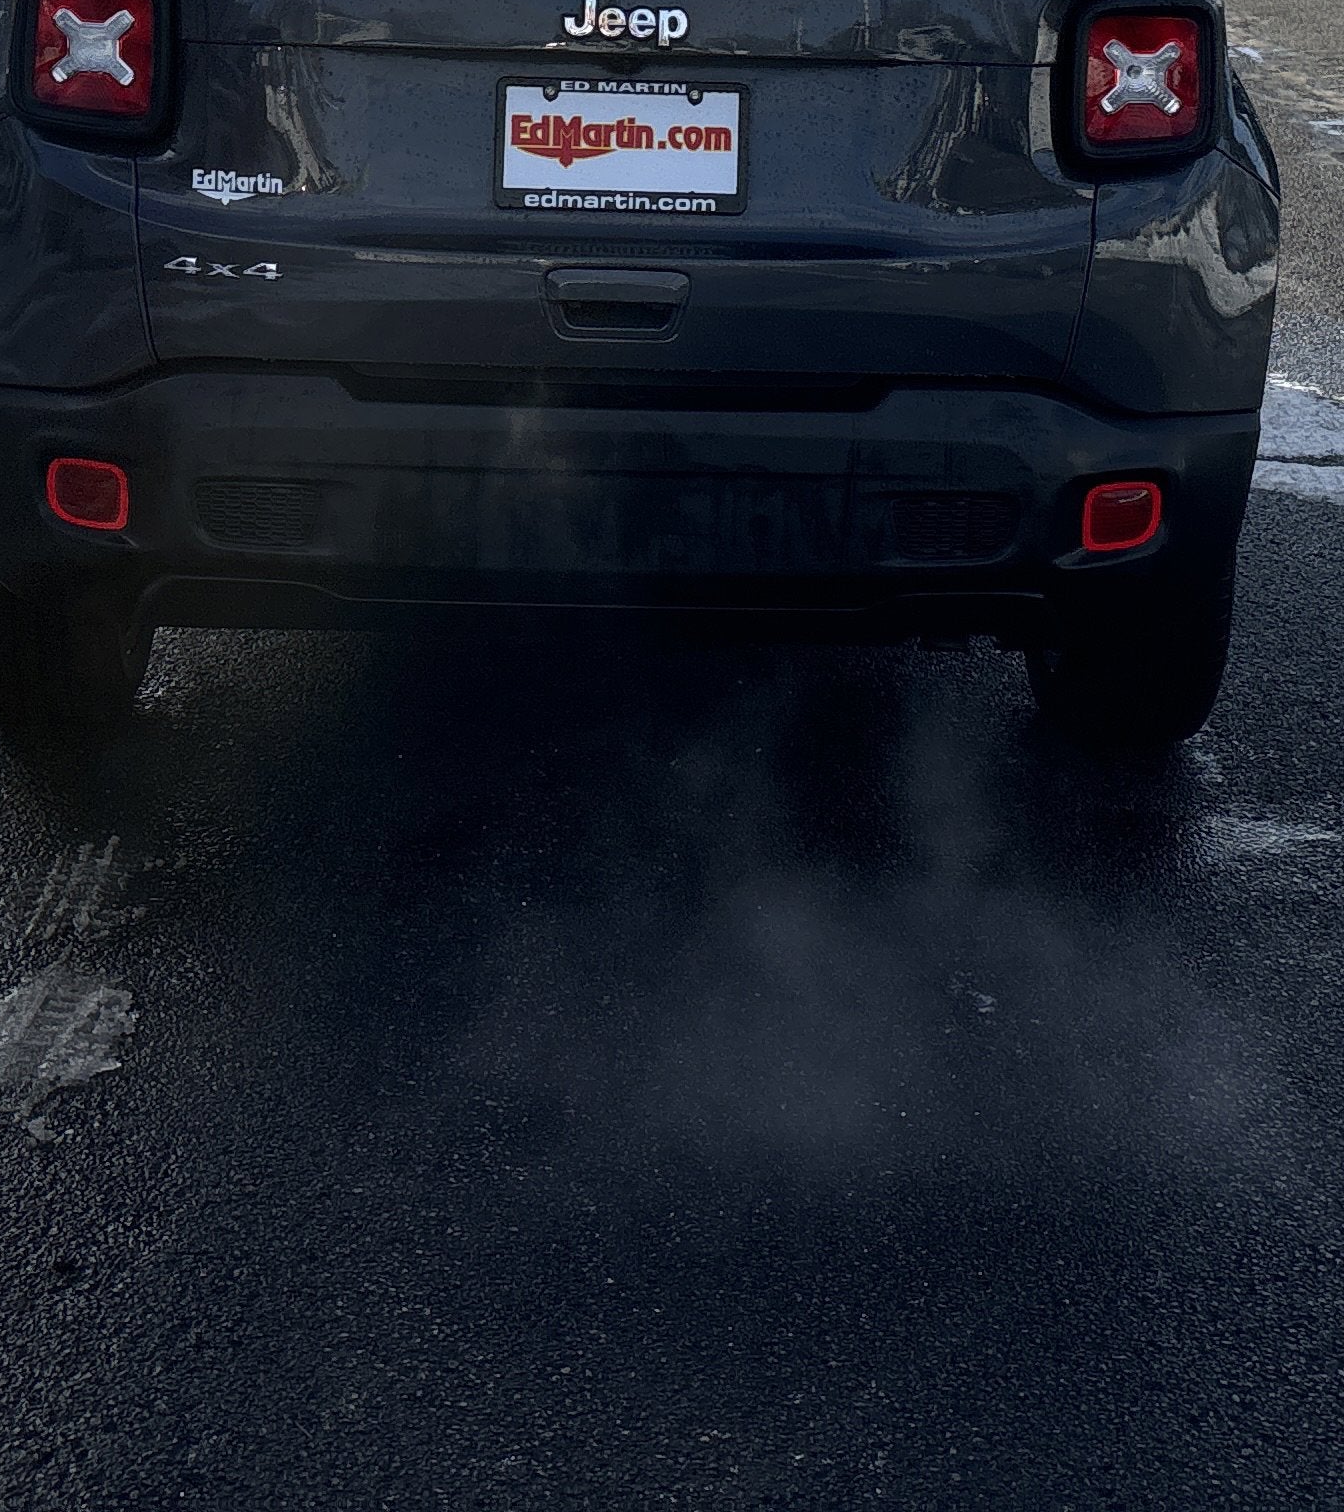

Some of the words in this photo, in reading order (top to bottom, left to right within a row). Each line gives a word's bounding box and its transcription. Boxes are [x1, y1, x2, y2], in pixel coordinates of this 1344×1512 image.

[560, 80, 590, 92] ED
[598, 81, 687, 94] MARTIN
[511, 114, 732, 157] EdMartin.com
[191, 168, 283, 195] EdMartin
[524, 190, 717, 212] edmartin.com
